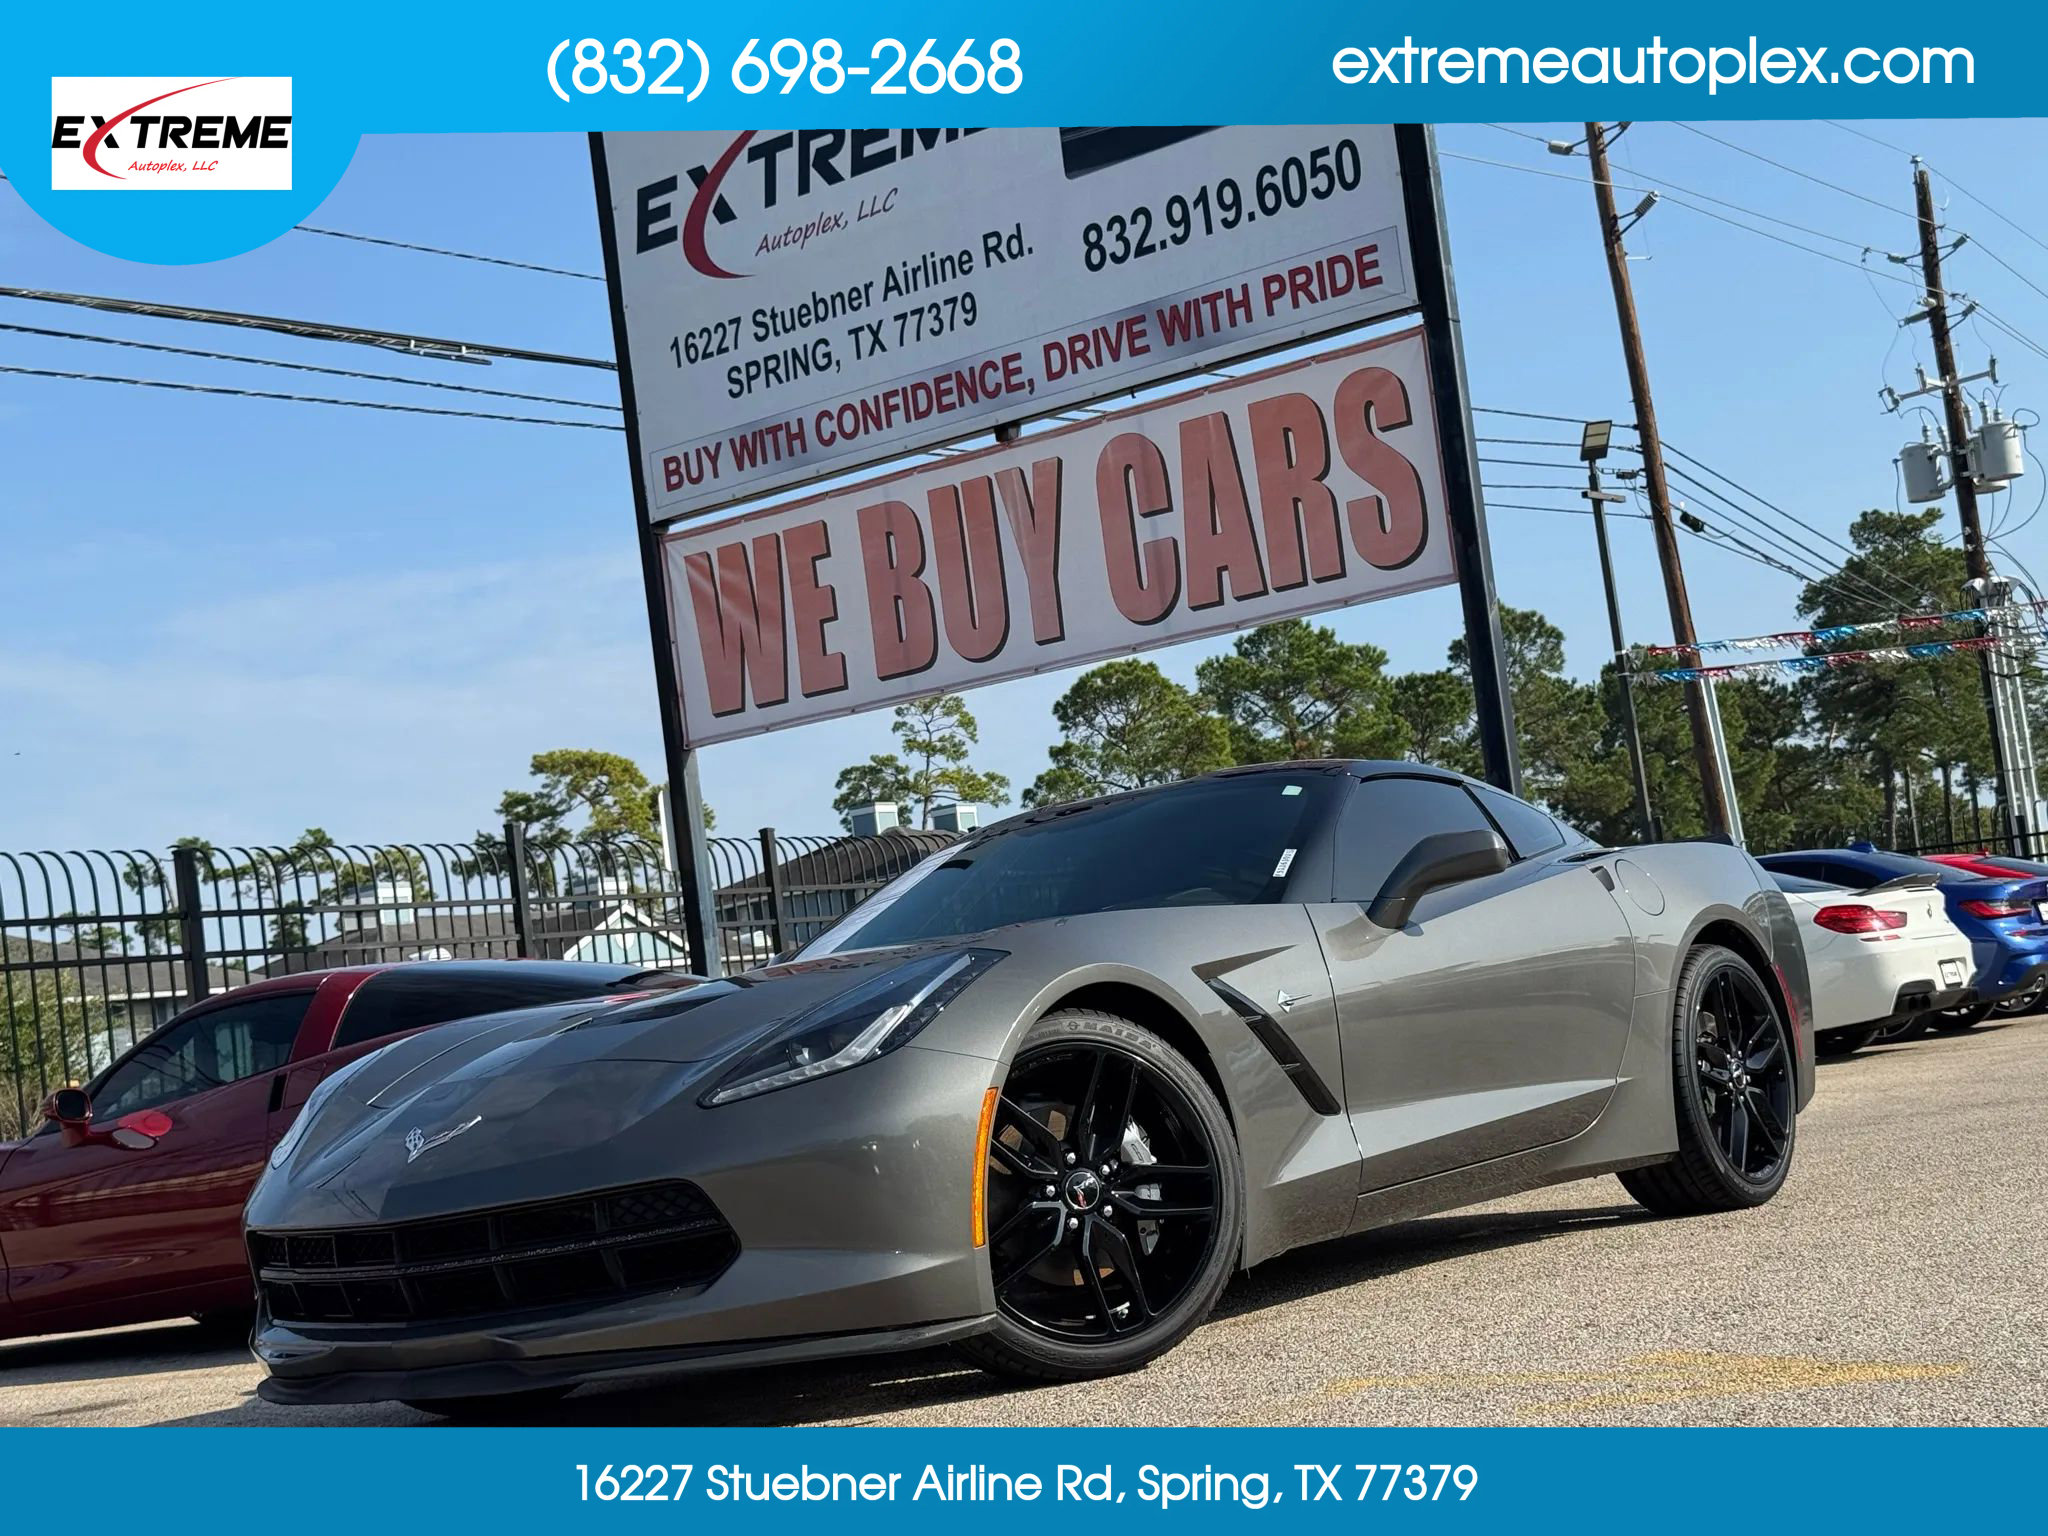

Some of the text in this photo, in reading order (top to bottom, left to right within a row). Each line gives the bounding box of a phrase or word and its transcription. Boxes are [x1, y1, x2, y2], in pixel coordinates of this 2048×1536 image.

[636, 128, 992, 255] EXTRE
[755, 187, 899, 257] Autoplex, LLC
[1082, 138, 1362, 272] 832.919.6050
[670, 223, 1034, 369] 16227 Stuebner Airline Rd.
[727, 291, 978, 399] SPRING, TX 77379
[663, 243, 1384, 493] BUY WITH CONFIDENCE, DRIVE WITH PRIDE
[684, 366, 1429, 718] WE BUY CARS
